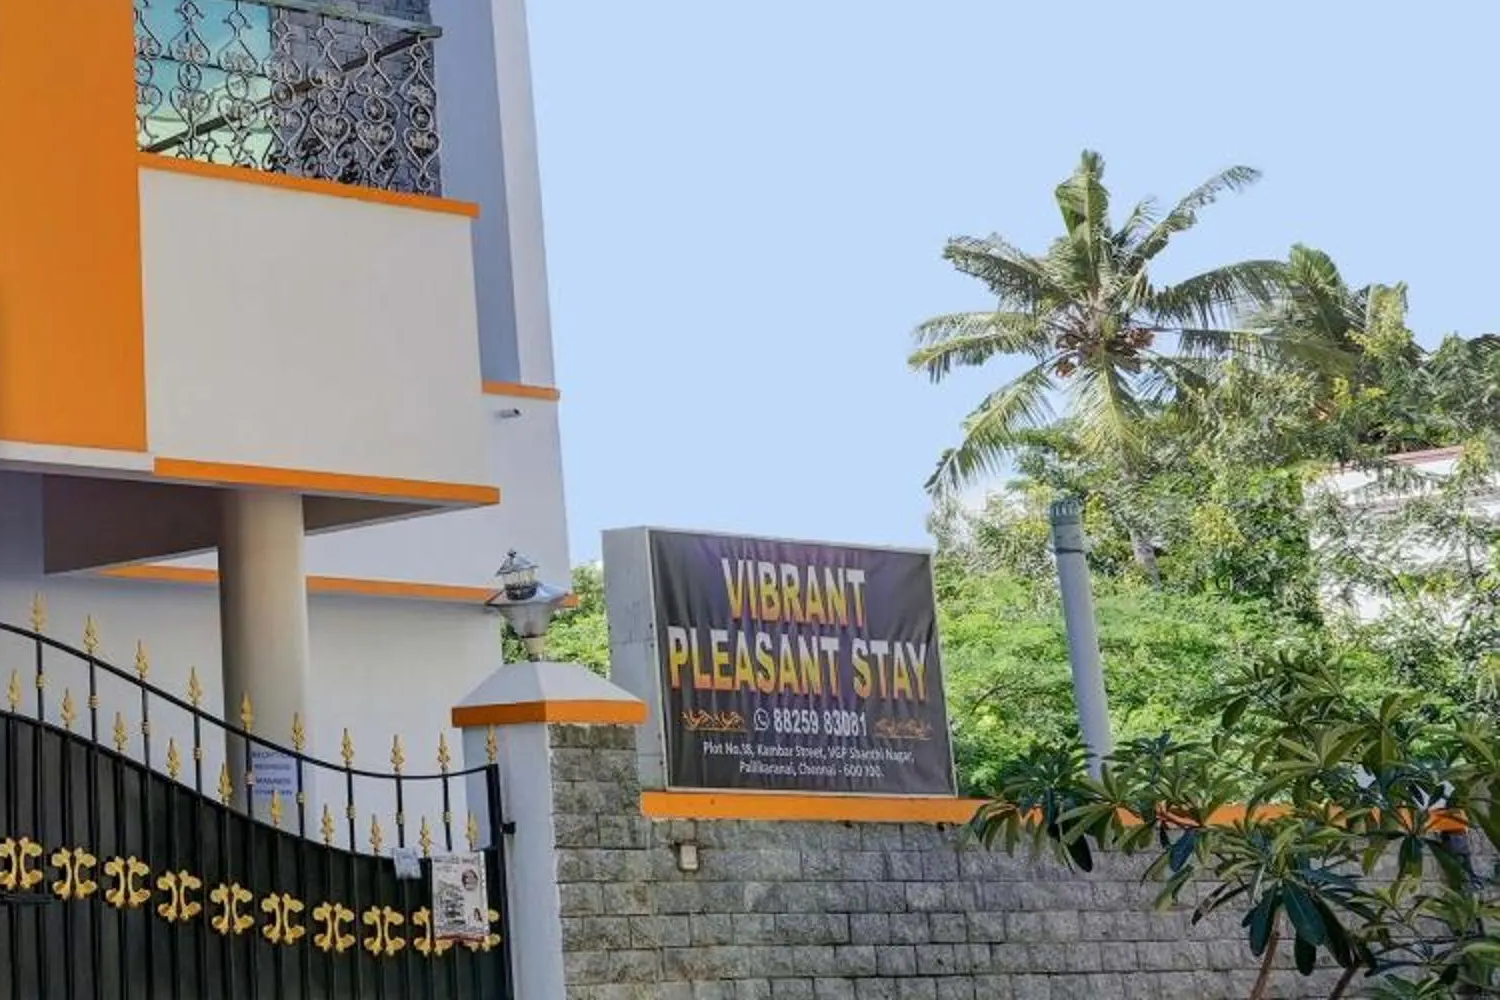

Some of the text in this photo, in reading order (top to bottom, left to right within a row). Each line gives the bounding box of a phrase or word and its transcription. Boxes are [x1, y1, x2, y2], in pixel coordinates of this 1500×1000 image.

[722, 557, 866, 628] VIBRANT
[667, 626, 928, 700] PLEASANT STAY
[773, 708, 819, 734] 88259
